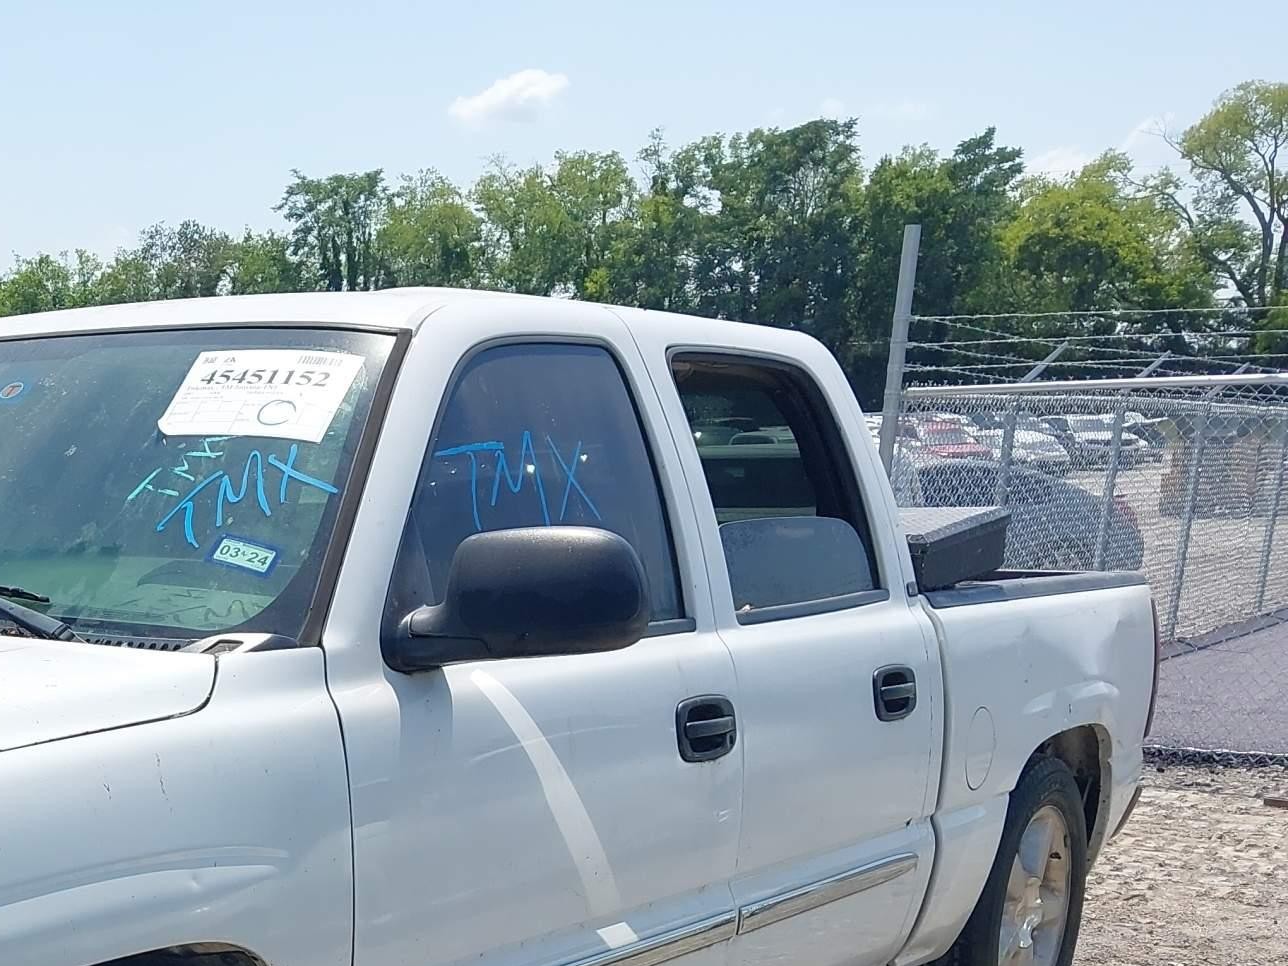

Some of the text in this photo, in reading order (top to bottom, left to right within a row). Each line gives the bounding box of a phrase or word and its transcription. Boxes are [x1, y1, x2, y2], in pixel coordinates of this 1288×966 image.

[201, 369, 330, 387] 45451152
[157, 444, 339, 549] TMX
[433, 430, 602, 531] TMX
